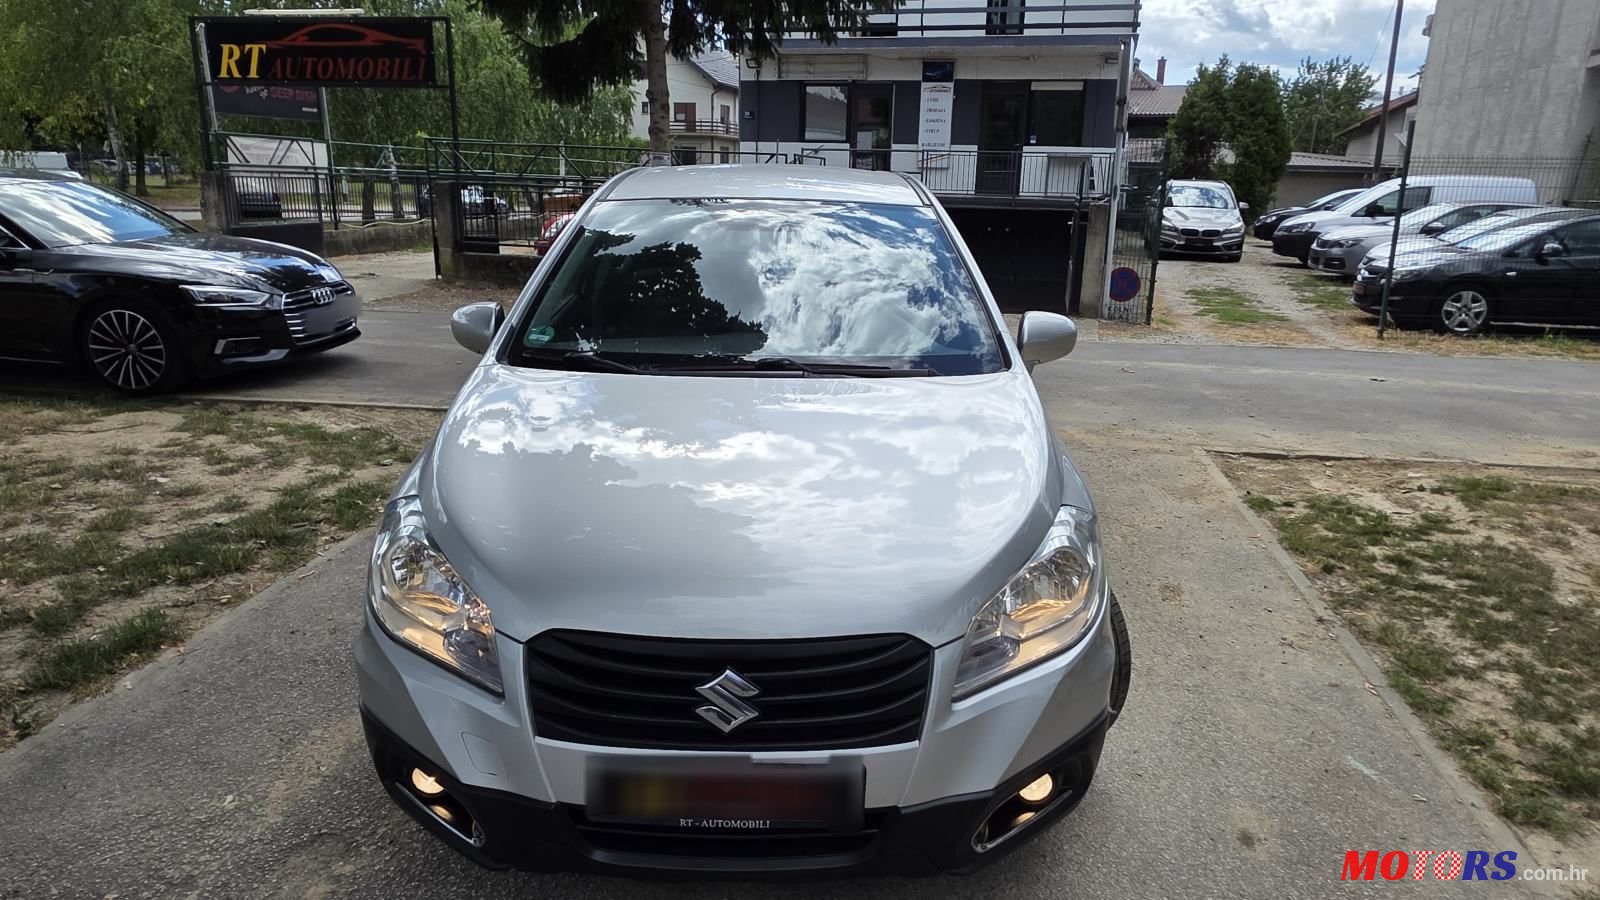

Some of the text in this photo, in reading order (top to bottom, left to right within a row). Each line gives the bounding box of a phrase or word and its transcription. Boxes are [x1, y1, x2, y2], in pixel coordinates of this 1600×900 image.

[217, 43, 427, 81] RT AUTOMOBILI
[680, 818, 694, 827] RT
[701, 819, 771, 829] AUTOMOBILI
